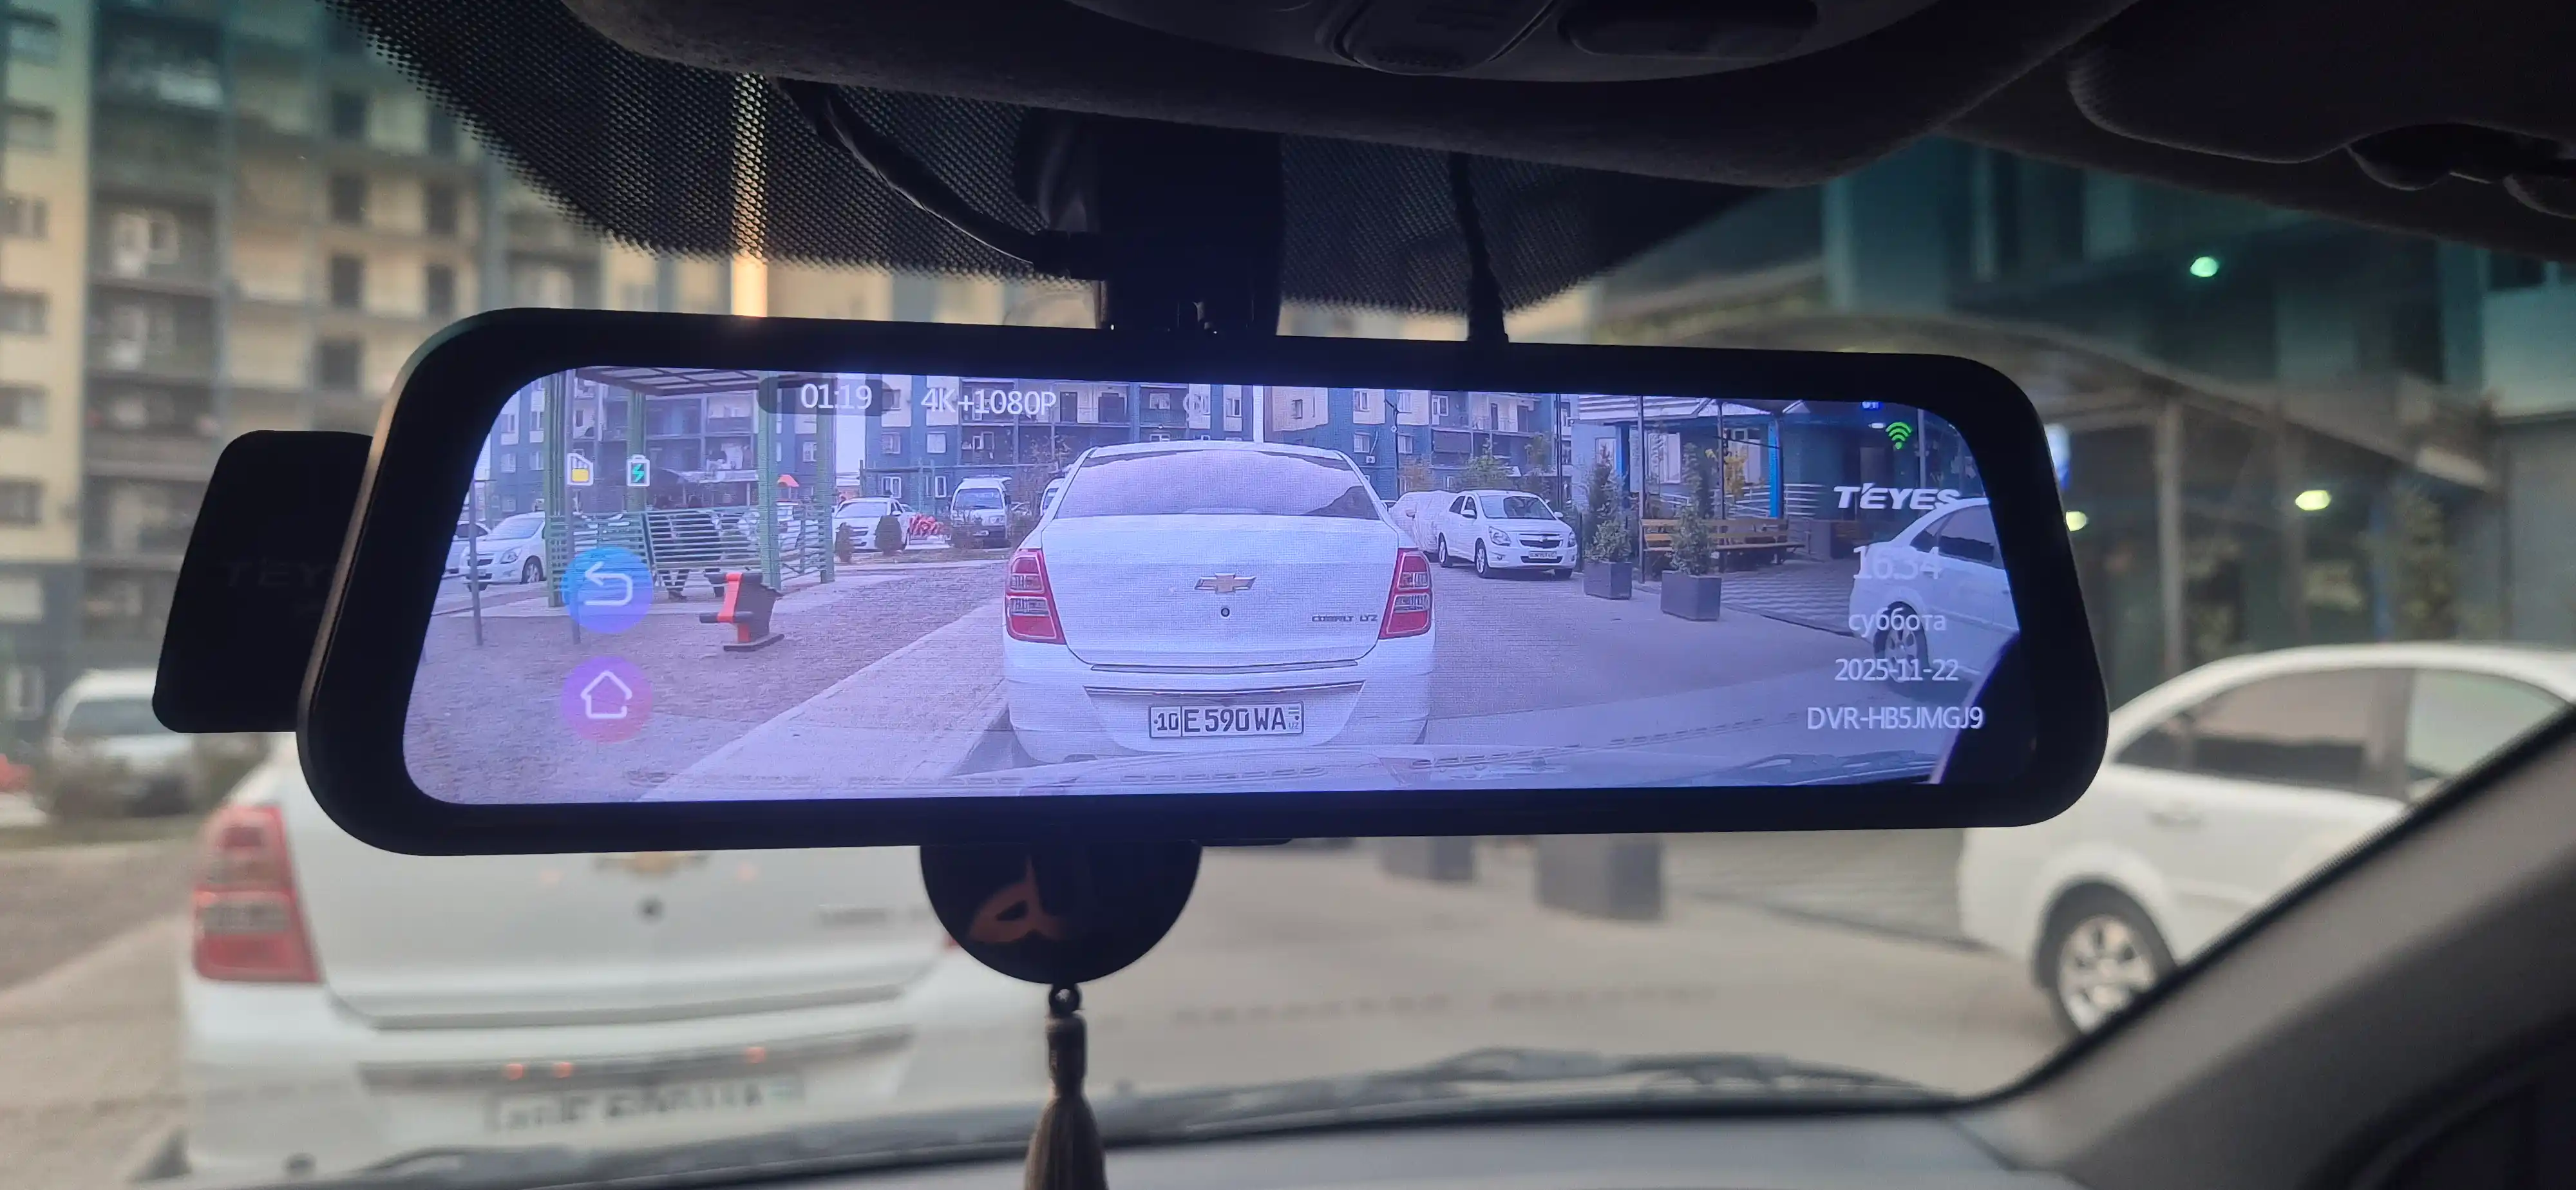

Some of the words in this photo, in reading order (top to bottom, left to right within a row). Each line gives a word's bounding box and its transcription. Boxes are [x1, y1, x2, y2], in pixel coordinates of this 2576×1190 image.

[800, 383, 873, 410] 01:19
[921, 387, 1057, 416] 4K+1080P
[1848, 607, 1947, 637] суббота
[1835, 658, 1959, 681] 2025-11-22
[1157, 712, 1179, 731] 10
[1807, 706, 1984, 730] DVR-HB5JMGJ9
